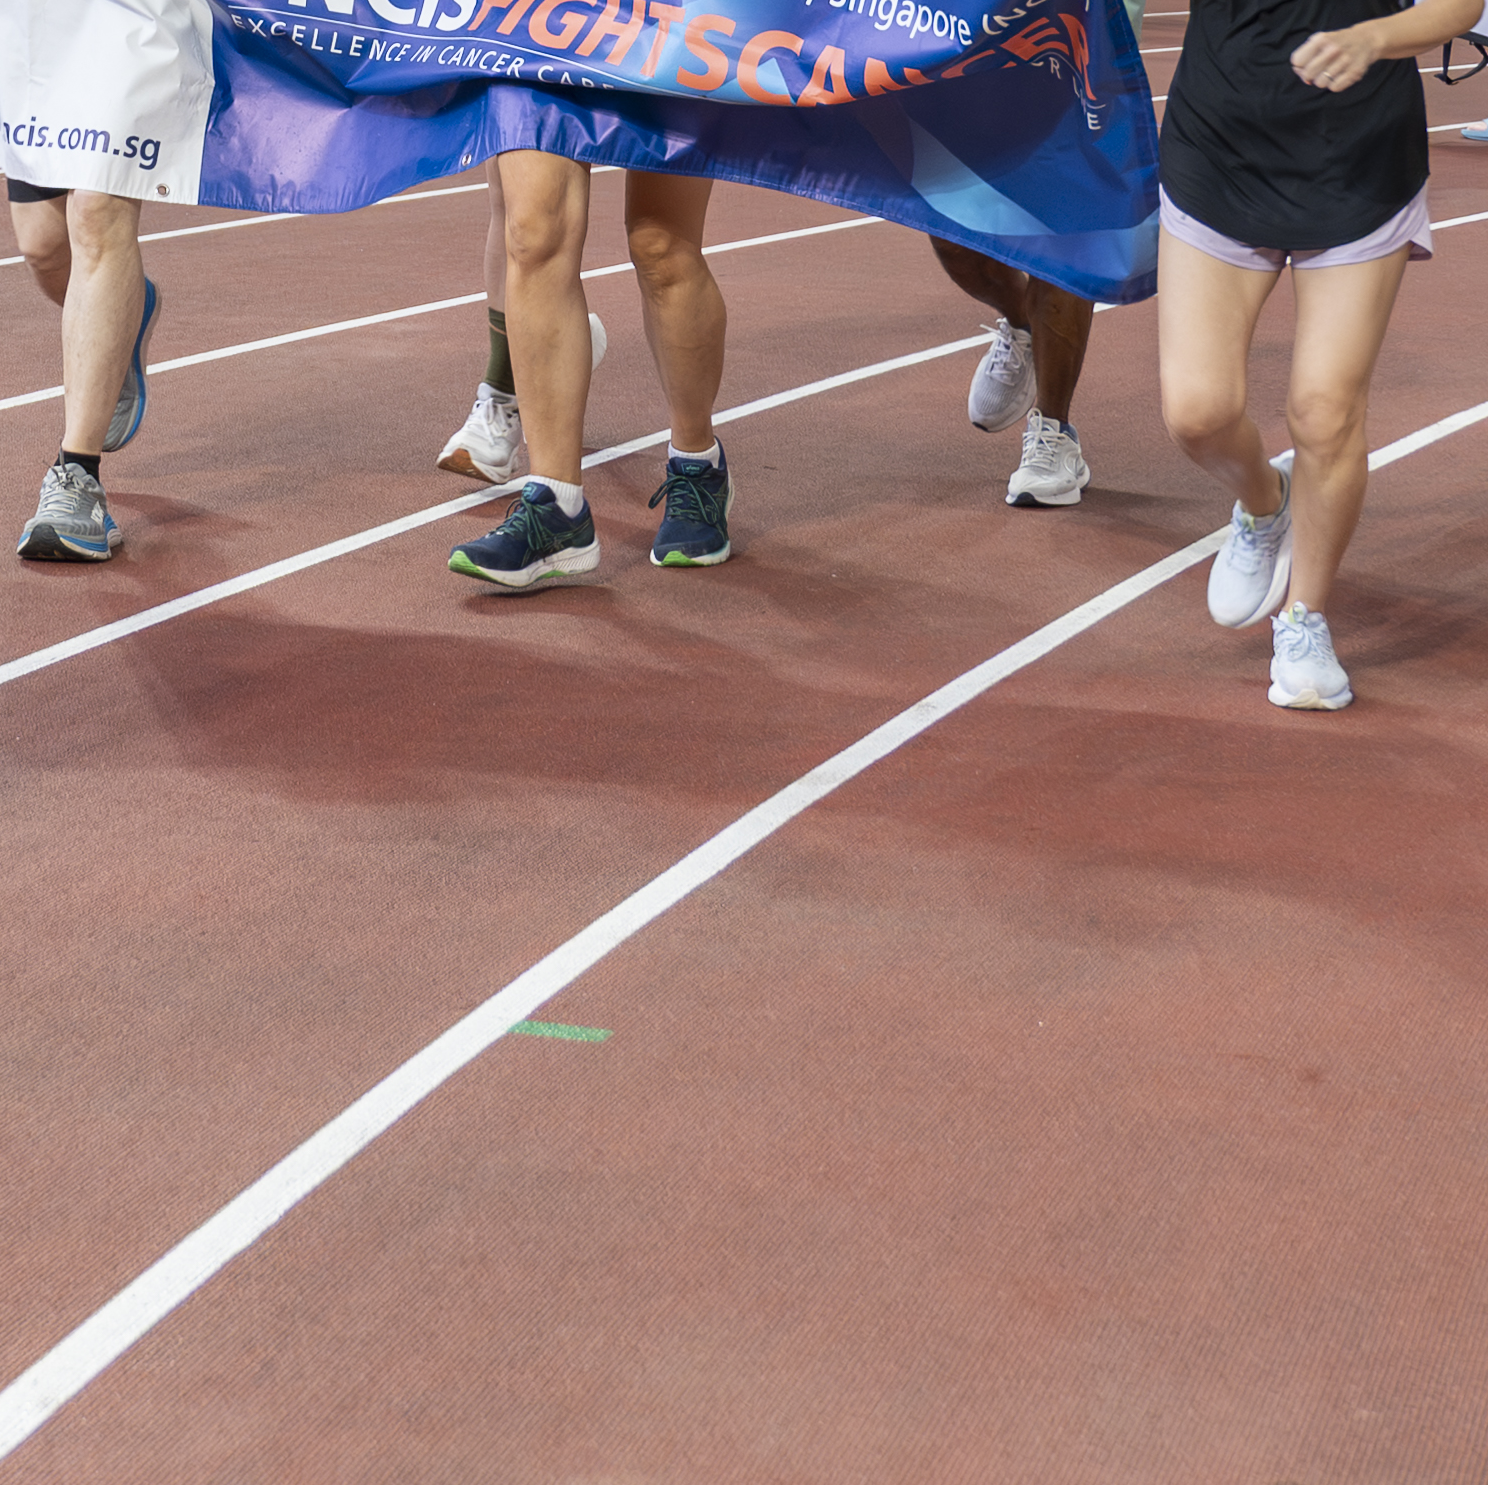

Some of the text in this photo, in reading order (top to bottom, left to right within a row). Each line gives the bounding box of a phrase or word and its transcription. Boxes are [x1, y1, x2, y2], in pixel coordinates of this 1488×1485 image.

[231, 13, 411, 63] EXCELLENCE
[410, 44, 437, 63] IN
[437, 44, 525, 79] CANCER
